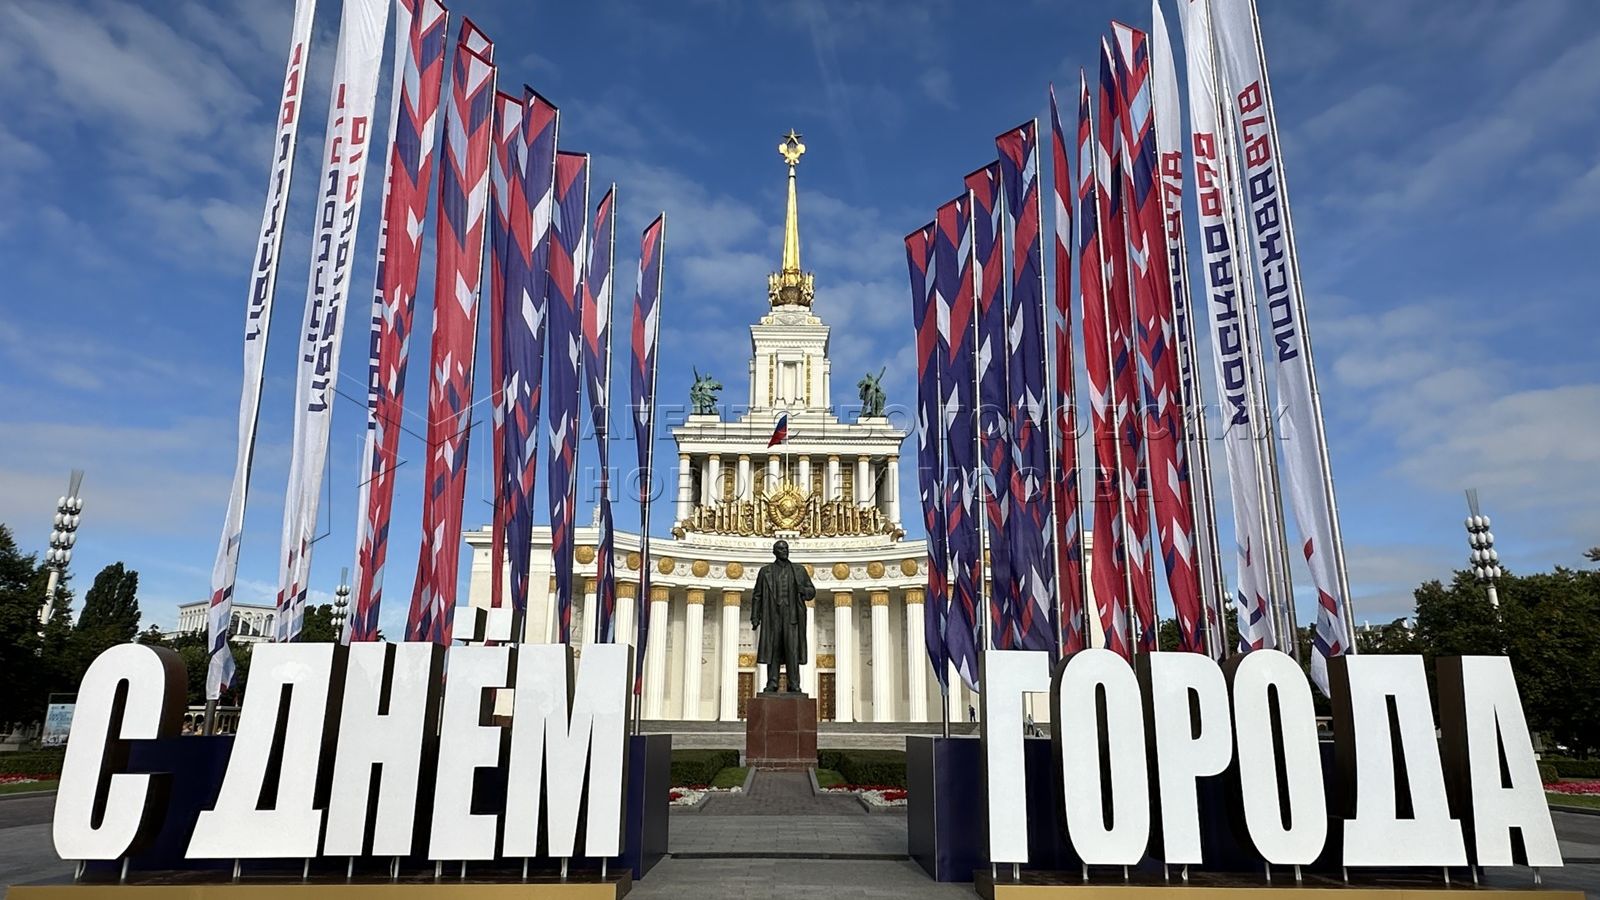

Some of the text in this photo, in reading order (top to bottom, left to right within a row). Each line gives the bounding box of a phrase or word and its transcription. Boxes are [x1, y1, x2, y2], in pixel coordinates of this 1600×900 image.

[1249, 166, 1298, 363] МОСКВА
[52, 606, 630, 861] С ДНЁМ
[984, 648, 1564, 867] ГОРОДА
